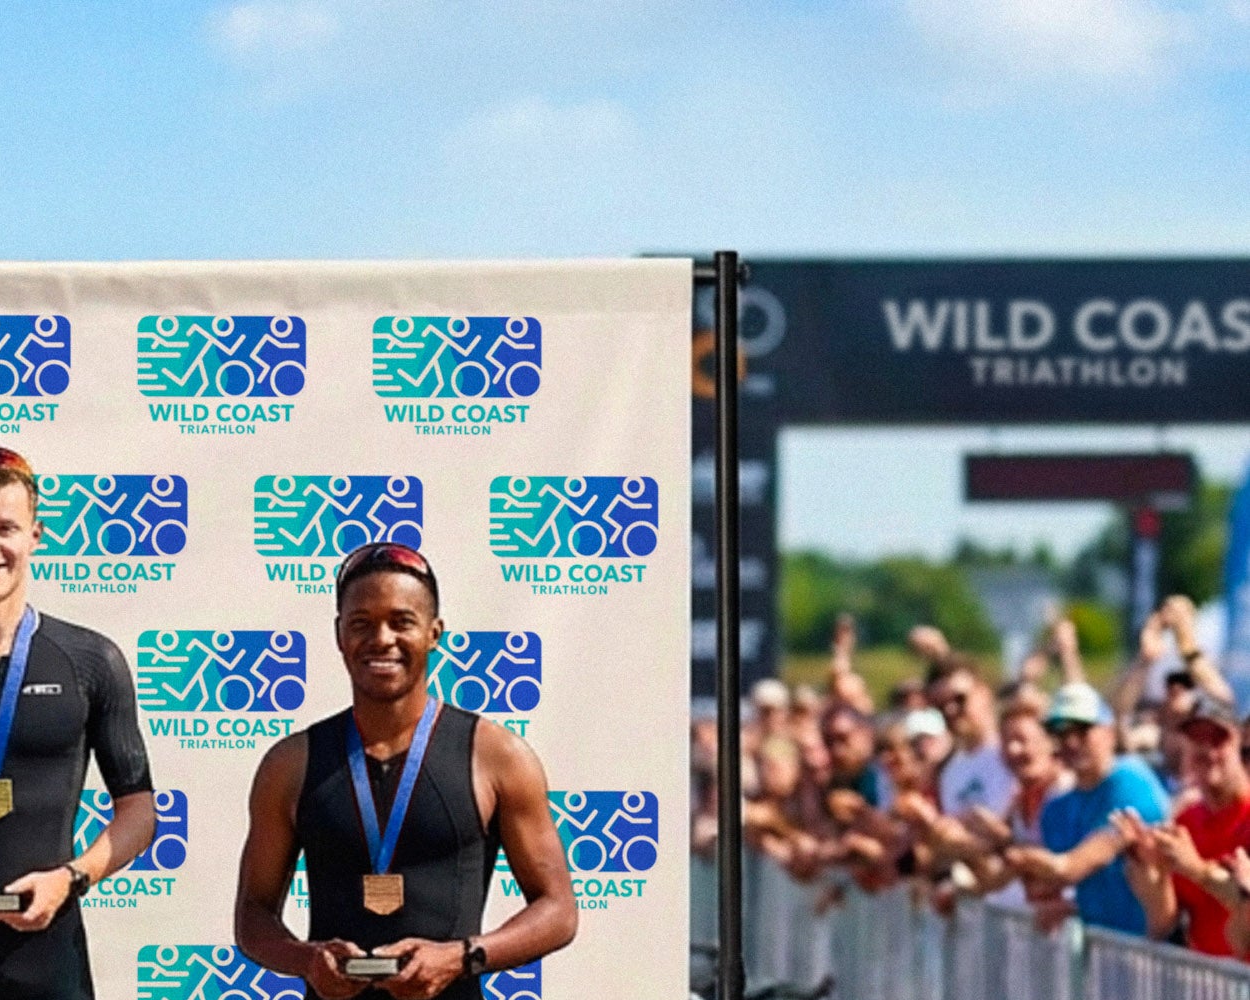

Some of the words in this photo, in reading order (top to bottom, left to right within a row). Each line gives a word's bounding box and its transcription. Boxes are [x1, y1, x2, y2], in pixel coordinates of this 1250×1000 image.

[883, 299, 1055, 351] WILD
[1074, 299, 1250, 351] COAS
[970, 357, 1188, 385] TRIATHLON
[148, 404, 209, 422] WILD
[215, 404, 294, 422] COAST
[383, 405, 444, 422] WILD
[450, 404, 530, 423] COAST
[180, 425, 255, 434] TRIATHLON
[415, 426, 490, 434] TRIATHLON
[29, 563, 90, 580] WILD
[97, 563, 176, 581] COAST
[264, 564, 326, 581] WILD
[500, 564, 561, 582] WILD
[567, 564, 646, 582] COAST
[61, 584, 136, 593] TRIATHLON
[297, 584, 333, 593] TRIAT
[532, 585, 607, 594] TRIATHLON
[148, 719, 209, 736] WILD
[215, 718, 294, 737] COAST
[180, 740, 255, 748] TRIATHLON
[97, 877, 176, 896] COAST
[289, 878, 309, 896] IL
[571, 879, 646, 897] COAST
